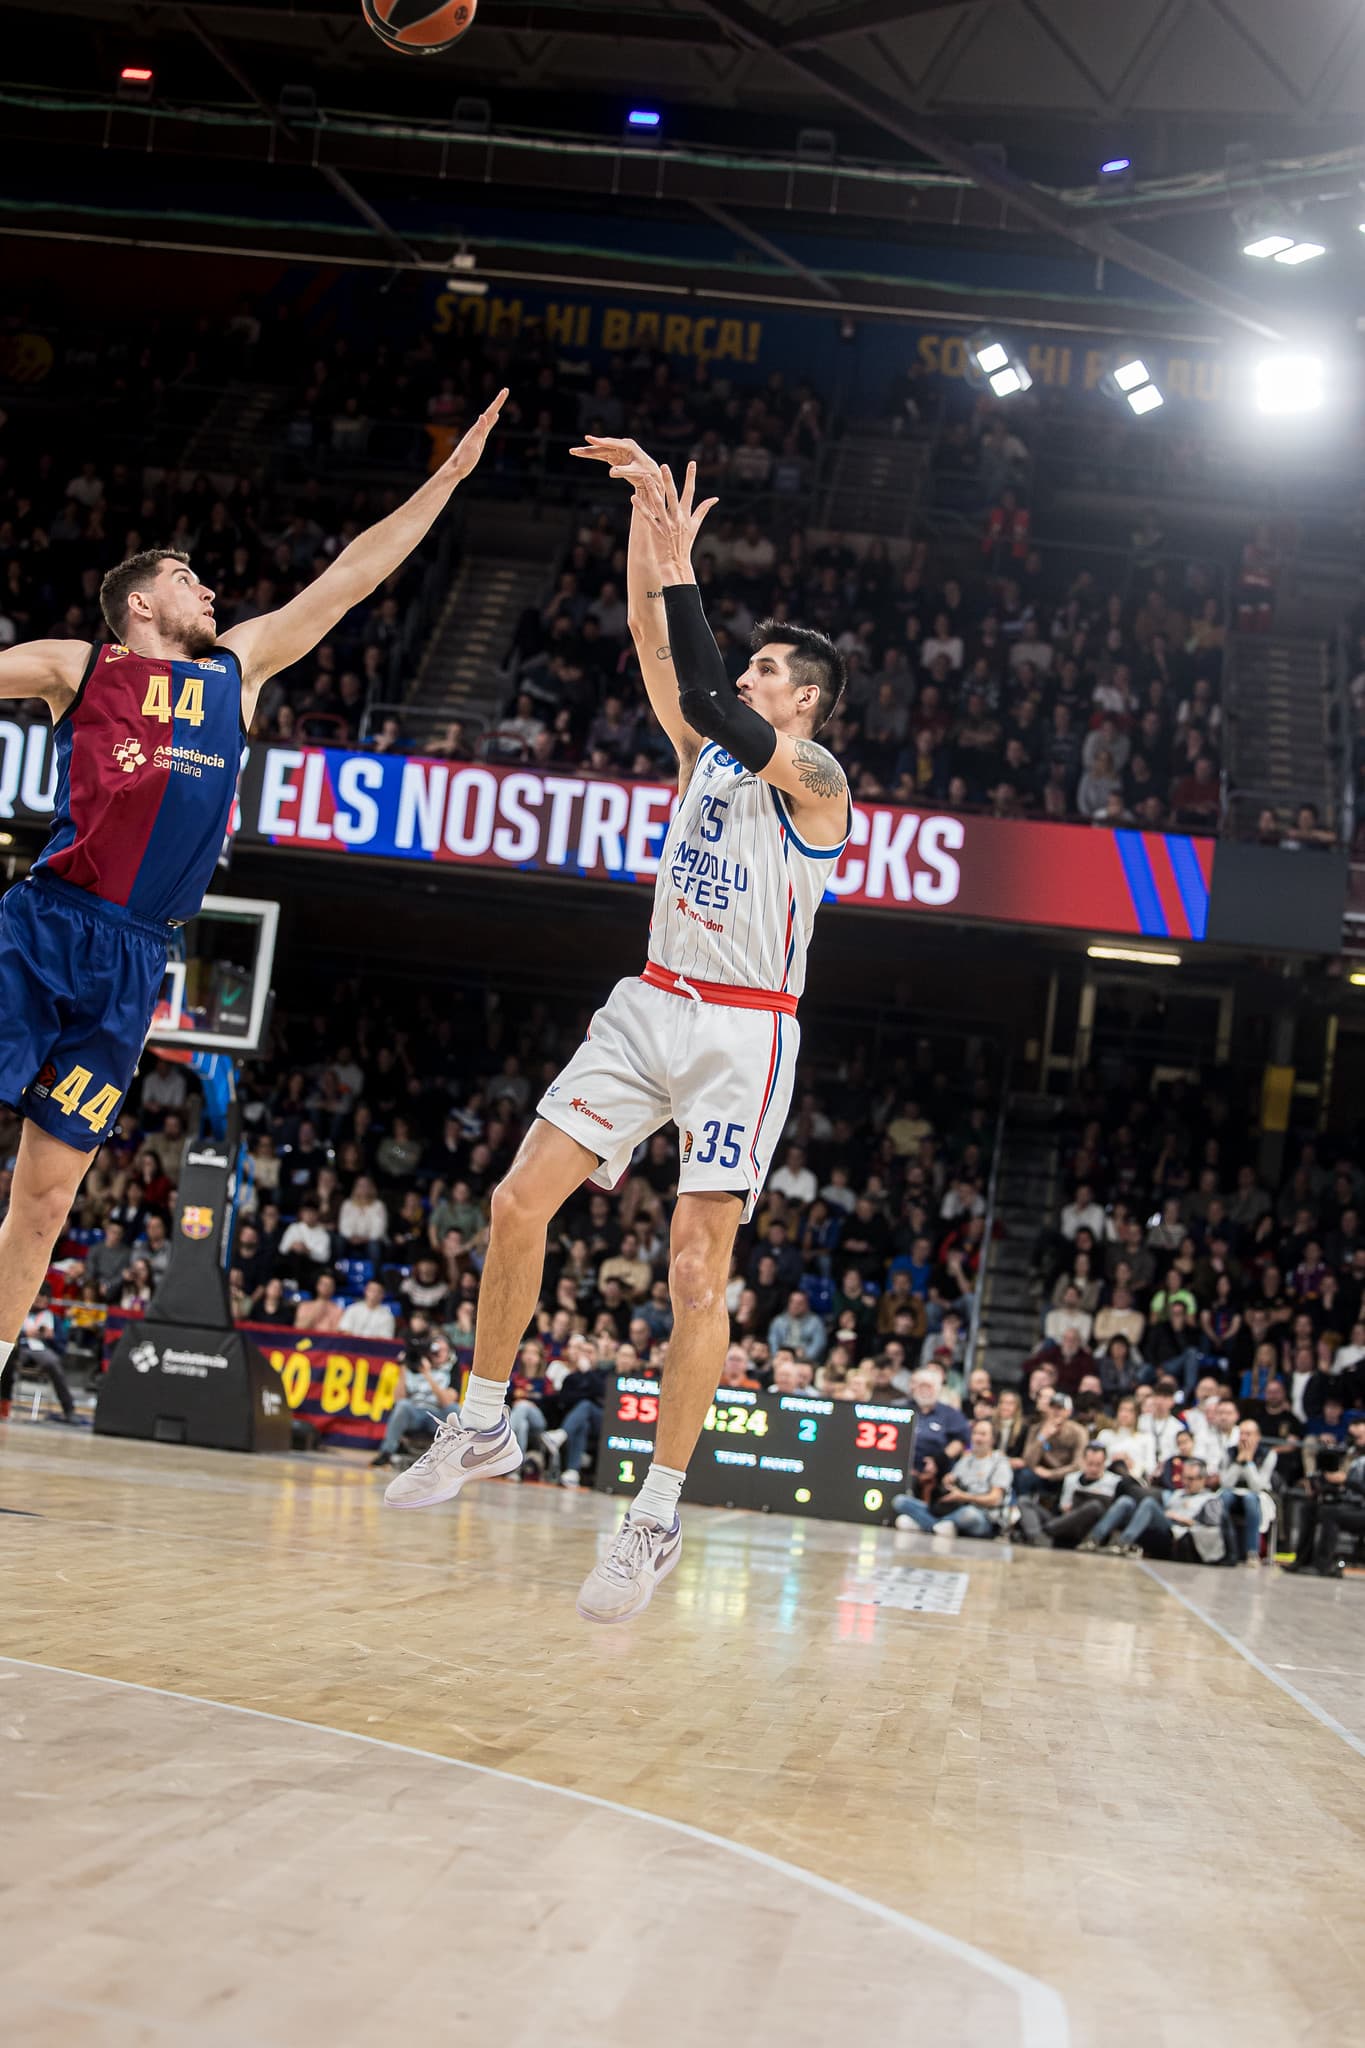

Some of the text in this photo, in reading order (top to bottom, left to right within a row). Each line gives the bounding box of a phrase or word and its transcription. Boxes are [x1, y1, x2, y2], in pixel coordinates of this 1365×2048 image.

[141, 675, 205, 727] 44
[152, 755, 203, 778] Sanitària
[153, 745, 226, 769] Assistència
[257, 748, 384, 845] ELS
[394, 762, 683, 875] NOSTRE
[671, 865, 729, 910] EFES
[50, 1064, 123, 1134] 44
[580, 1105, 614, 1131] corendon
[696, 1120, 745, 1169] 35
[617, 1394, 659, 1423] 35
[798, 1418, 818, 1442] 2
[855, 1421, 898, 1451] 32
[618, 1460, 636, 1483] 1
[863, 1488, 884, 1511] 0
